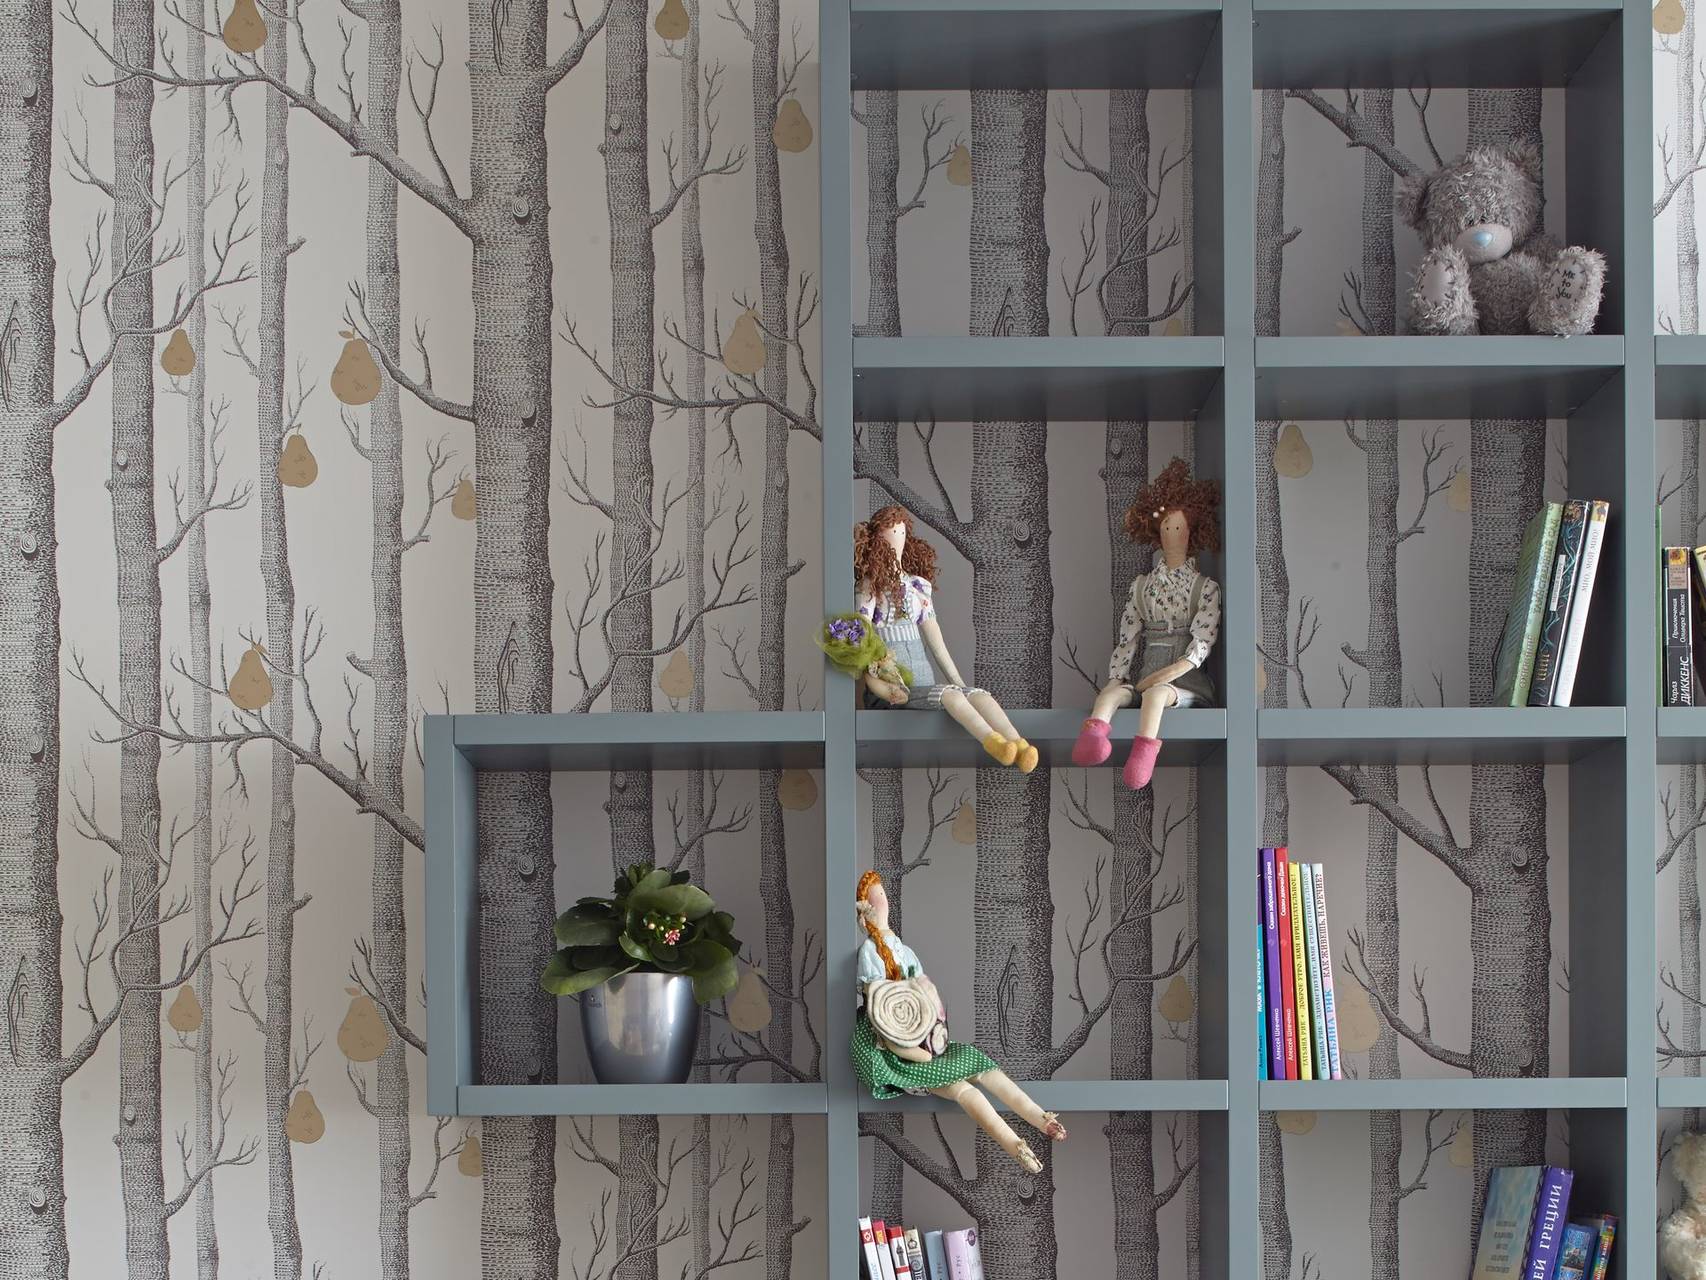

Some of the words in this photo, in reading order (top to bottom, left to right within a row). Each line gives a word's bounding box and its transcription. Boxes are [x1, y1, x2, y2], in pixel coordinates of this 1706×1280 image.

[1670, 680, 1678, 703] Чарлз
[1679, 655, 1690, 704] ДИККЕНС
[1314, 873, 1324, 916] НАРЕЧИЕ?
[1324, 988, 1333, 1012] РИК
[1327, 1017, 1338, 1072] ТАТЬЯНА
[1539, 1184, 1563, 1250] ГРЕЦИИ
